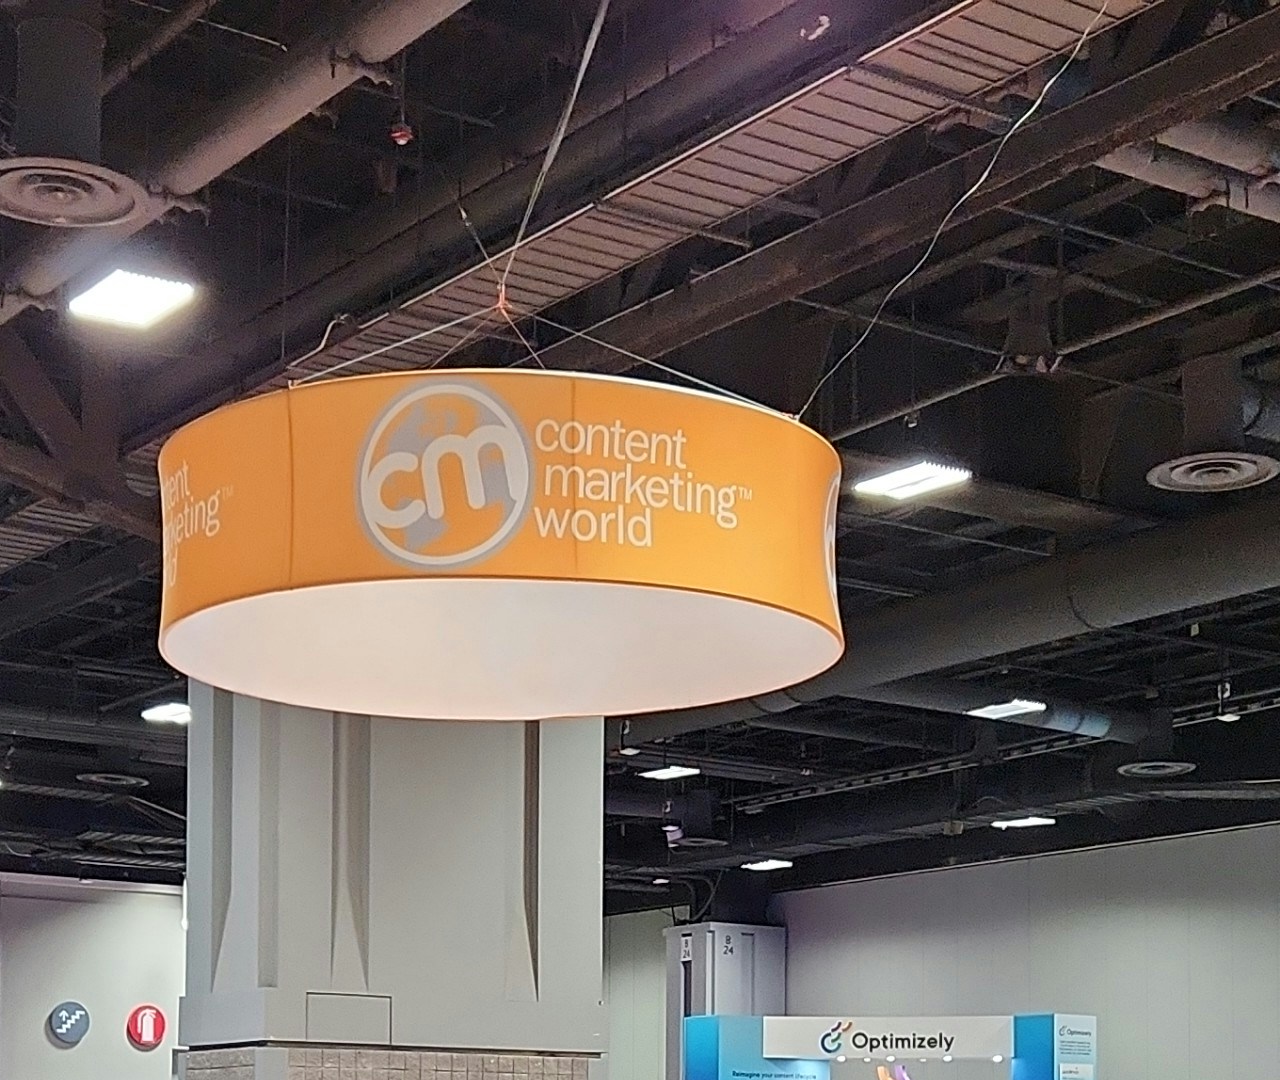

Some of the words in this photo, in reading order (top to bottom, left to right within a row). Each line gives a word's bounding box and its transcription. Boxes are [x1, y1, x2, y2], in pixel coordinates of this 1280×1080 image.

[535, 418, 687, 470] content
[534, 504, 653, 548] world
[684, 939, 689, 948] B
[725, 935, 732, 945] B
[682, 949, 691, 959] 24
[723, 945, 734, 955] 24
[852, 1031, 955, 1052] Optimizely
